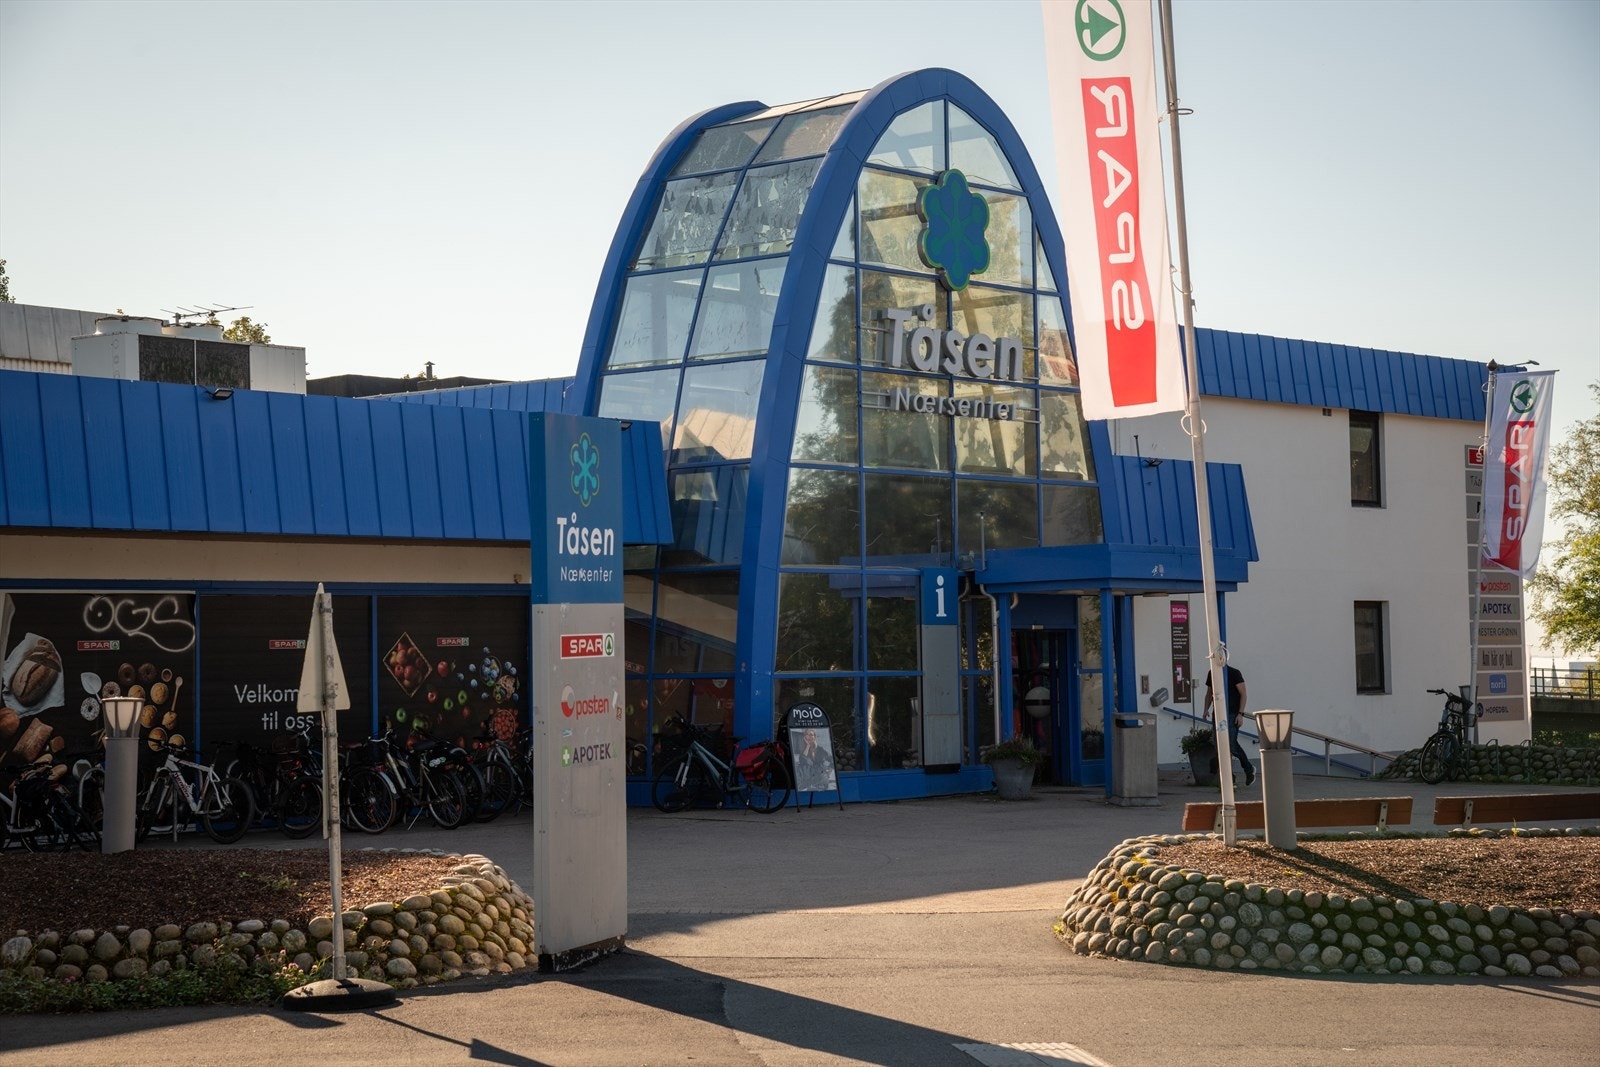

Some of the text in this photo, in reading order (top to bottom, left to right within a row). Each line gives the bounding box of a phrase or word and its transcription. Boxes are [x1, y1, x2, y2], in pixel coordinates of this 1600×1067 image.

[884, 303, 1023, 380] Tåsen
[894, 387, 1017, 420] Nærsenter
[1506, 423, 1531, 541] SPAR
[557, 512, 614, 555] Tåsen
[561, 566, 613, 581] Nærsenter
[1487, 580, 1511, 592] posten
[1483, 603, 1512, 614] APOTEK
[570, 638, 603, 654] SPAR
[1490, 678, 1506, 689] norli
[234, 684, 299, 703] Velkom
[576, 695, 609, 720] posten
[261, 711, 314, 730] til oss
[573, 743, 611, 764] APOTEK
